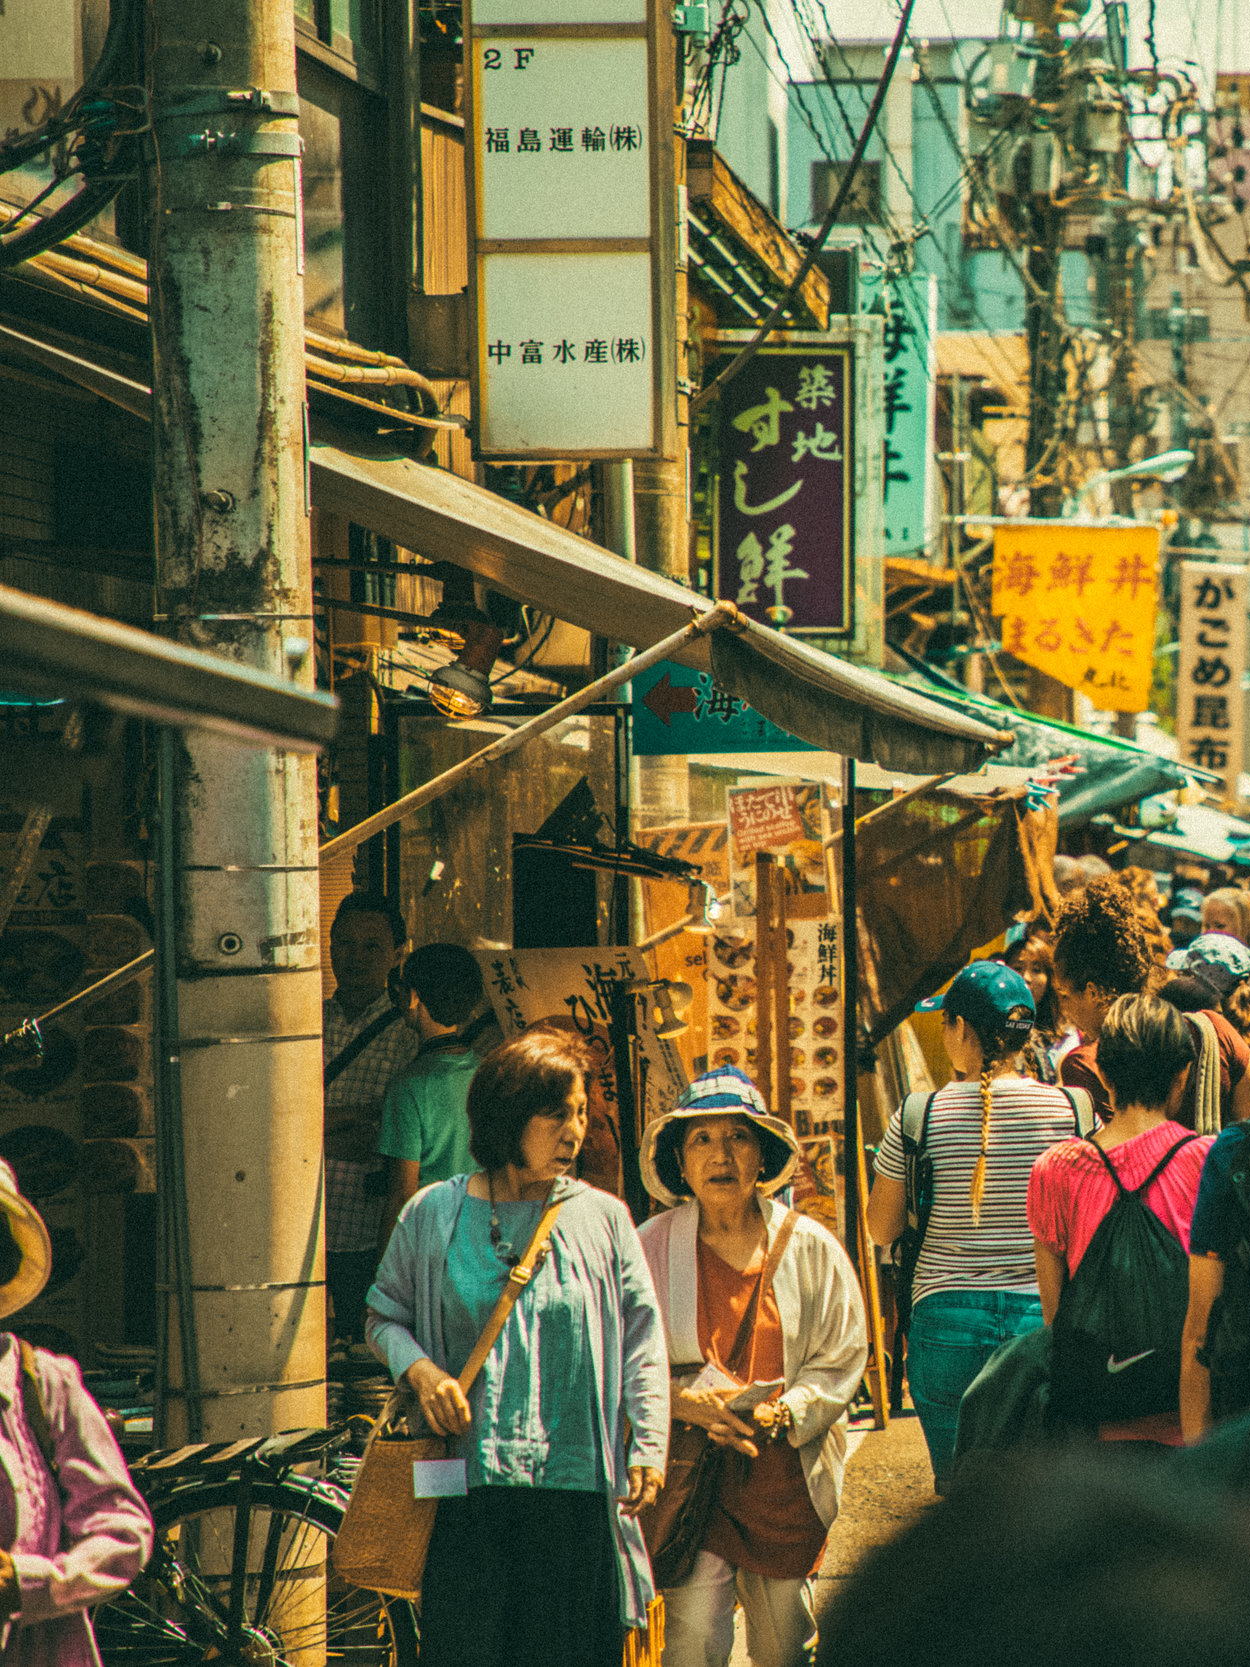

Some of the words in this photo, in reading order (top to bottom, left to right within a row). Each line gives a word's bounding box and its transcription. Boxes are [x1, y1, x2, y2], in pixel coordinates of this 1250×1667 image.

[484, 48, 535, 70] 2F
[484, 123, 642, 153] 福島運輸(株)
[487, 335, 646, 365] 中富水産(株)
[791, 364, 843, 462] 築地
[732, 386, 810, 605] すし鮮
[817, 923, 837, 986] 海鮮丼
